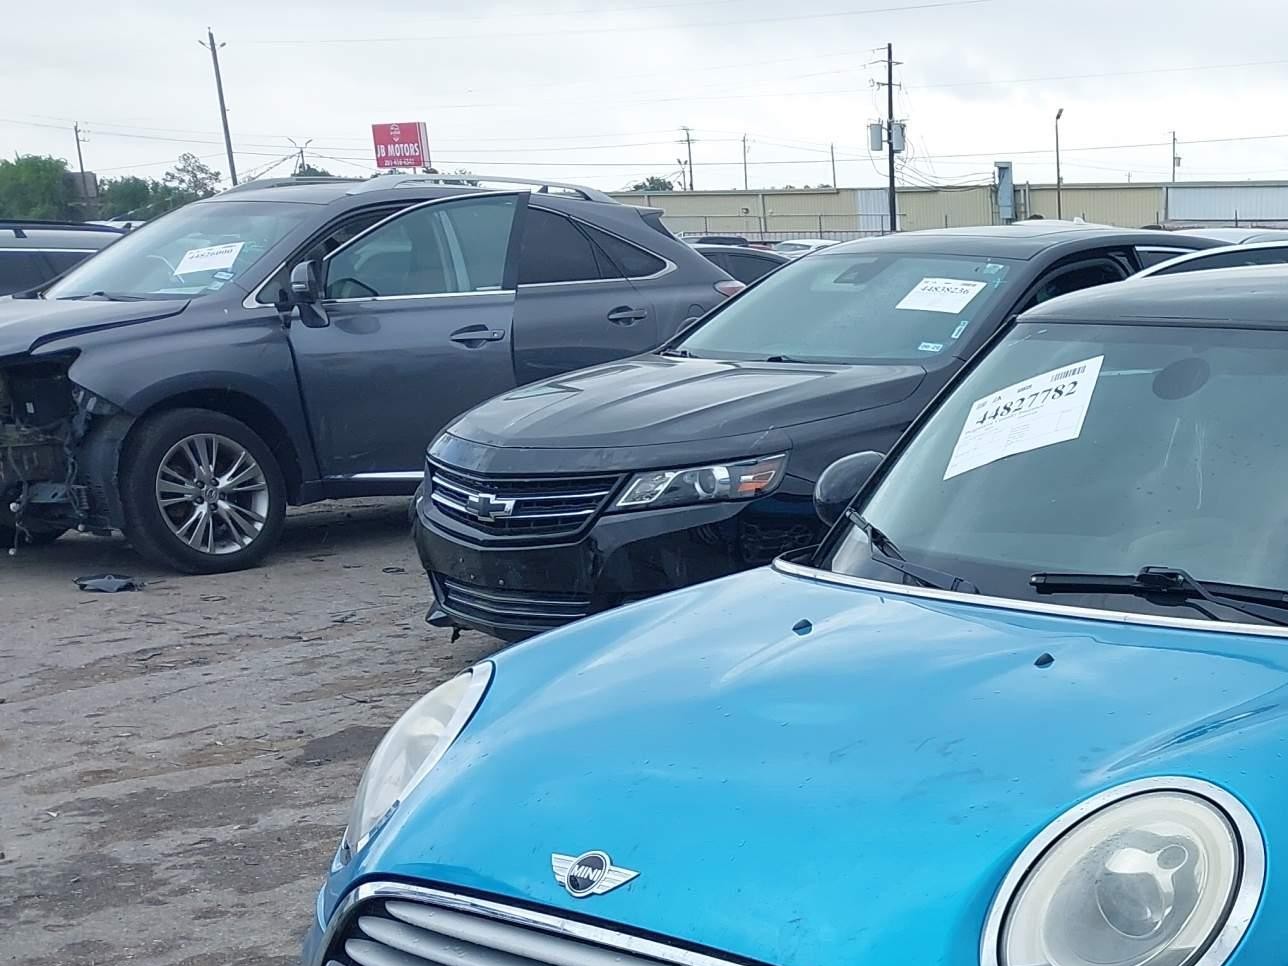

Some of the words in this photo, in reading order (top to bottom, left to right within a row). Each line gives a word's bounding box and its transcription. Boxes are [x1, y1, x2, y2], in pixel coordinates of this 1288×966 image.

[377, 144, 386, 157] JB
[388, 143, 419, 157] MOTORS
[976, 381, 1078, 424] 44827782
[571, 865, 602, 881] MINI
